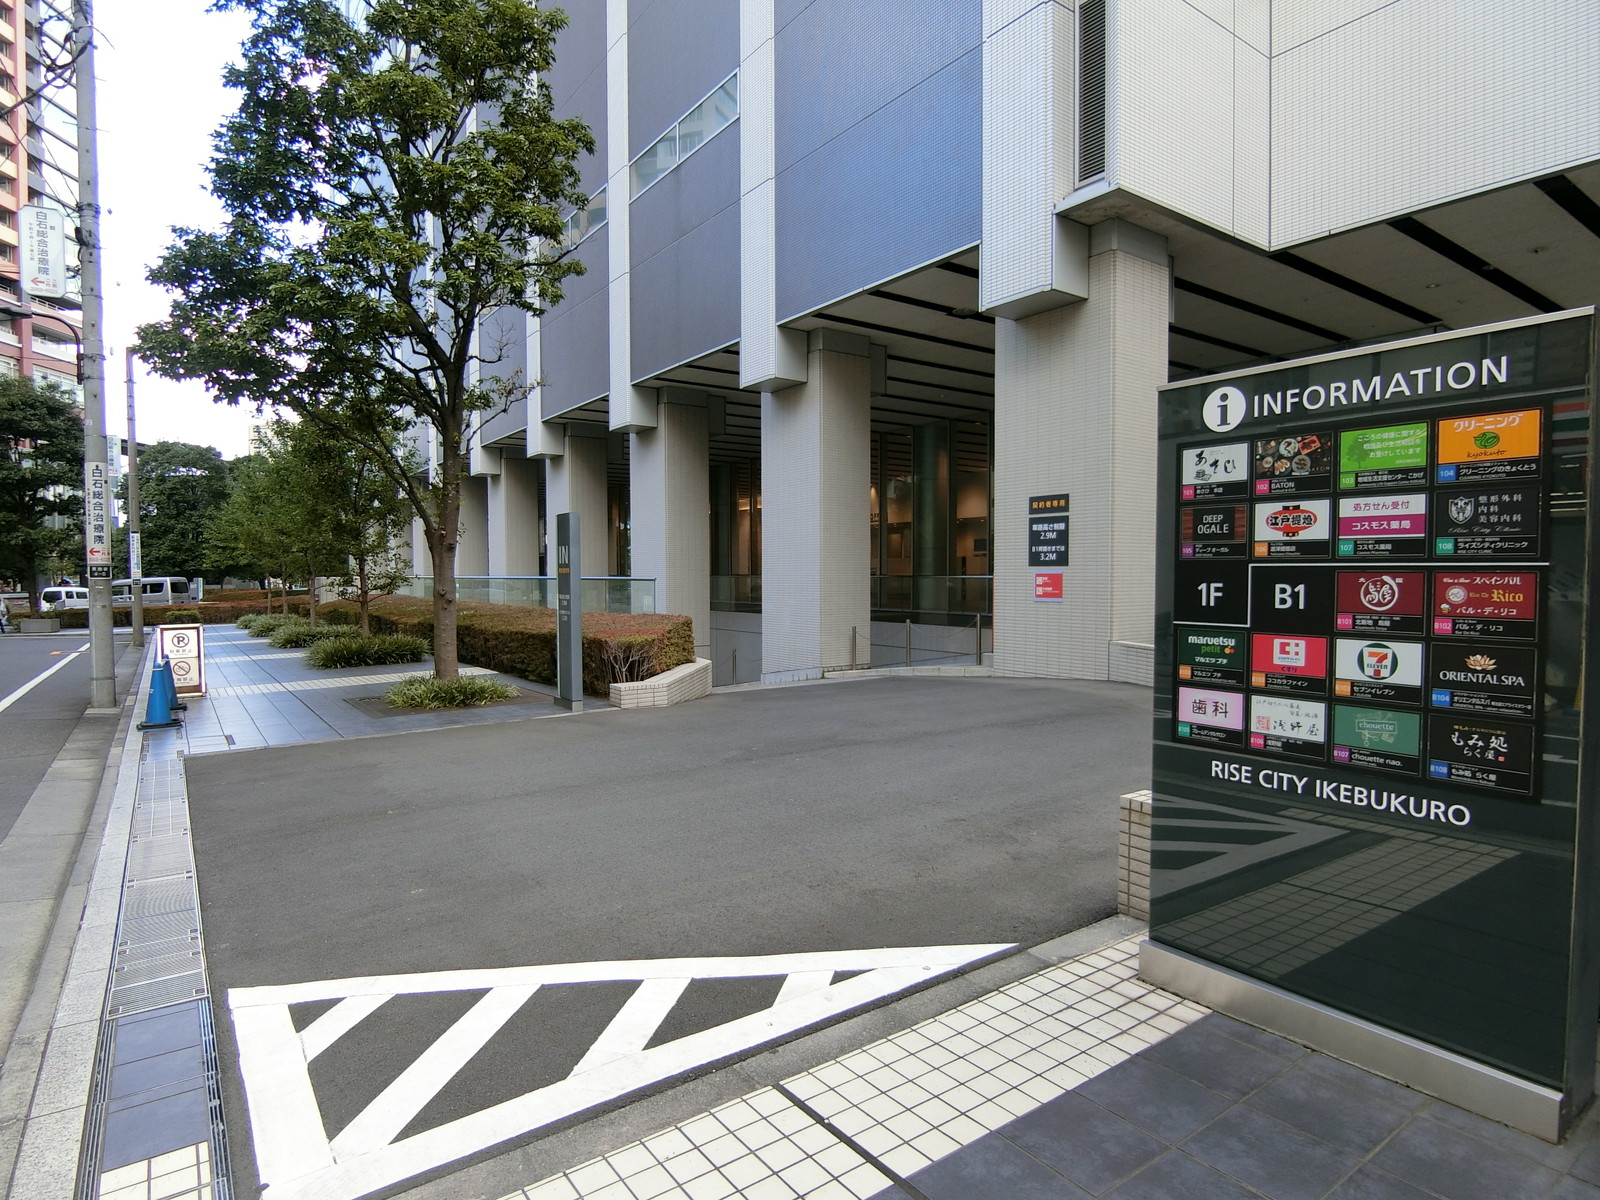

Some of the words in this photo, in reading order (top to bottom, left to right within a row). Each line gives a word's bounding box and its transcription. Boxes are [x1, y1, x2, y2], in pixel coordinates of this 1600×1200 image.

[1253, 355, 1508, 418] INFORMATION
[1453, 413, 1524, 432] クリーニング
[1467, 450, 1508, 459] kyokuto
[1459, 463, 1537, 475] クリーニングのきょくとう
[1271, 481, 1295, 489] BATON
[1478, 493, 1522, 503] 整形外科
[92, 468, 105, 545] 白石総合治療院
[1032, 499, 1066, 509] 契約者専用
[1353, 500, 1410, 512] 処方せん受付
[1478, 505, 1498, 513] 内科
[1202, 514, 1224, 523] DEEP
[1479, 513, 1522, 523] 美容内科
[1197, 523, 1229, 534] OGALE
[1352, 520, 1411, 530] コスモス薬局
[1040, 532, 1057, 540] 2.9M
[1457, 541, 1528, 549] ライズシティクリニック
[558, 545, 569, 564] IN
[1039, 552, 1056, 561] 3.2M
[1472, 576, 1521, 585] スペインバル
[1197, 583, 1224, 606] 1F
[1274, 583, 1305, 610] B1
[1491, 589, 1524, 602] Rico
[1456, 606, 1517, 616] バル・デ・リコ
[1434, 621, 1452, 629] B102
[1455, 623, 1504, 632] バル・デ・リコ
[1188, 635, 1236, 646] maruetsu
[1201, 645, 1221, 654] petit
[1194, 656, 1216, 664] マルエツ
[1367, 651, 1389, 677] 7
[1267, 677, 1308, 687] ココカラファイン
[1439, 670, 1500, 685] ORIENTAL
[1501, 675, 1525, 687] SPA
[1353, 686, 1395, 695] セブンイレブン
[1432, 693, 1450, 701] B104
[1453, 696, 1490, 705] オリエンタルスパ
[1191, 699, 1229, 718] 歯科
[1359, 721, 1394, 730] chouette
[1451, 731, 1508, 752] もみ処
[1333, 750, 1349, 758] B107
[1463, 747, 1496, 760] らく屋
[1351, 752, 1384, 764] chouette
[1386, 759, 1403, 767] nao.
[1430, 765, 1448, 773] B108
[1451, 768, 1472, 777] もみ処
[1475, 771, 1496, 781] らく屋
[1210, 760, 1253, 784] RISE
[1258, 769, 1308, 794] CITY
[1315, 779, 1472, 826] IKEBUKURO
